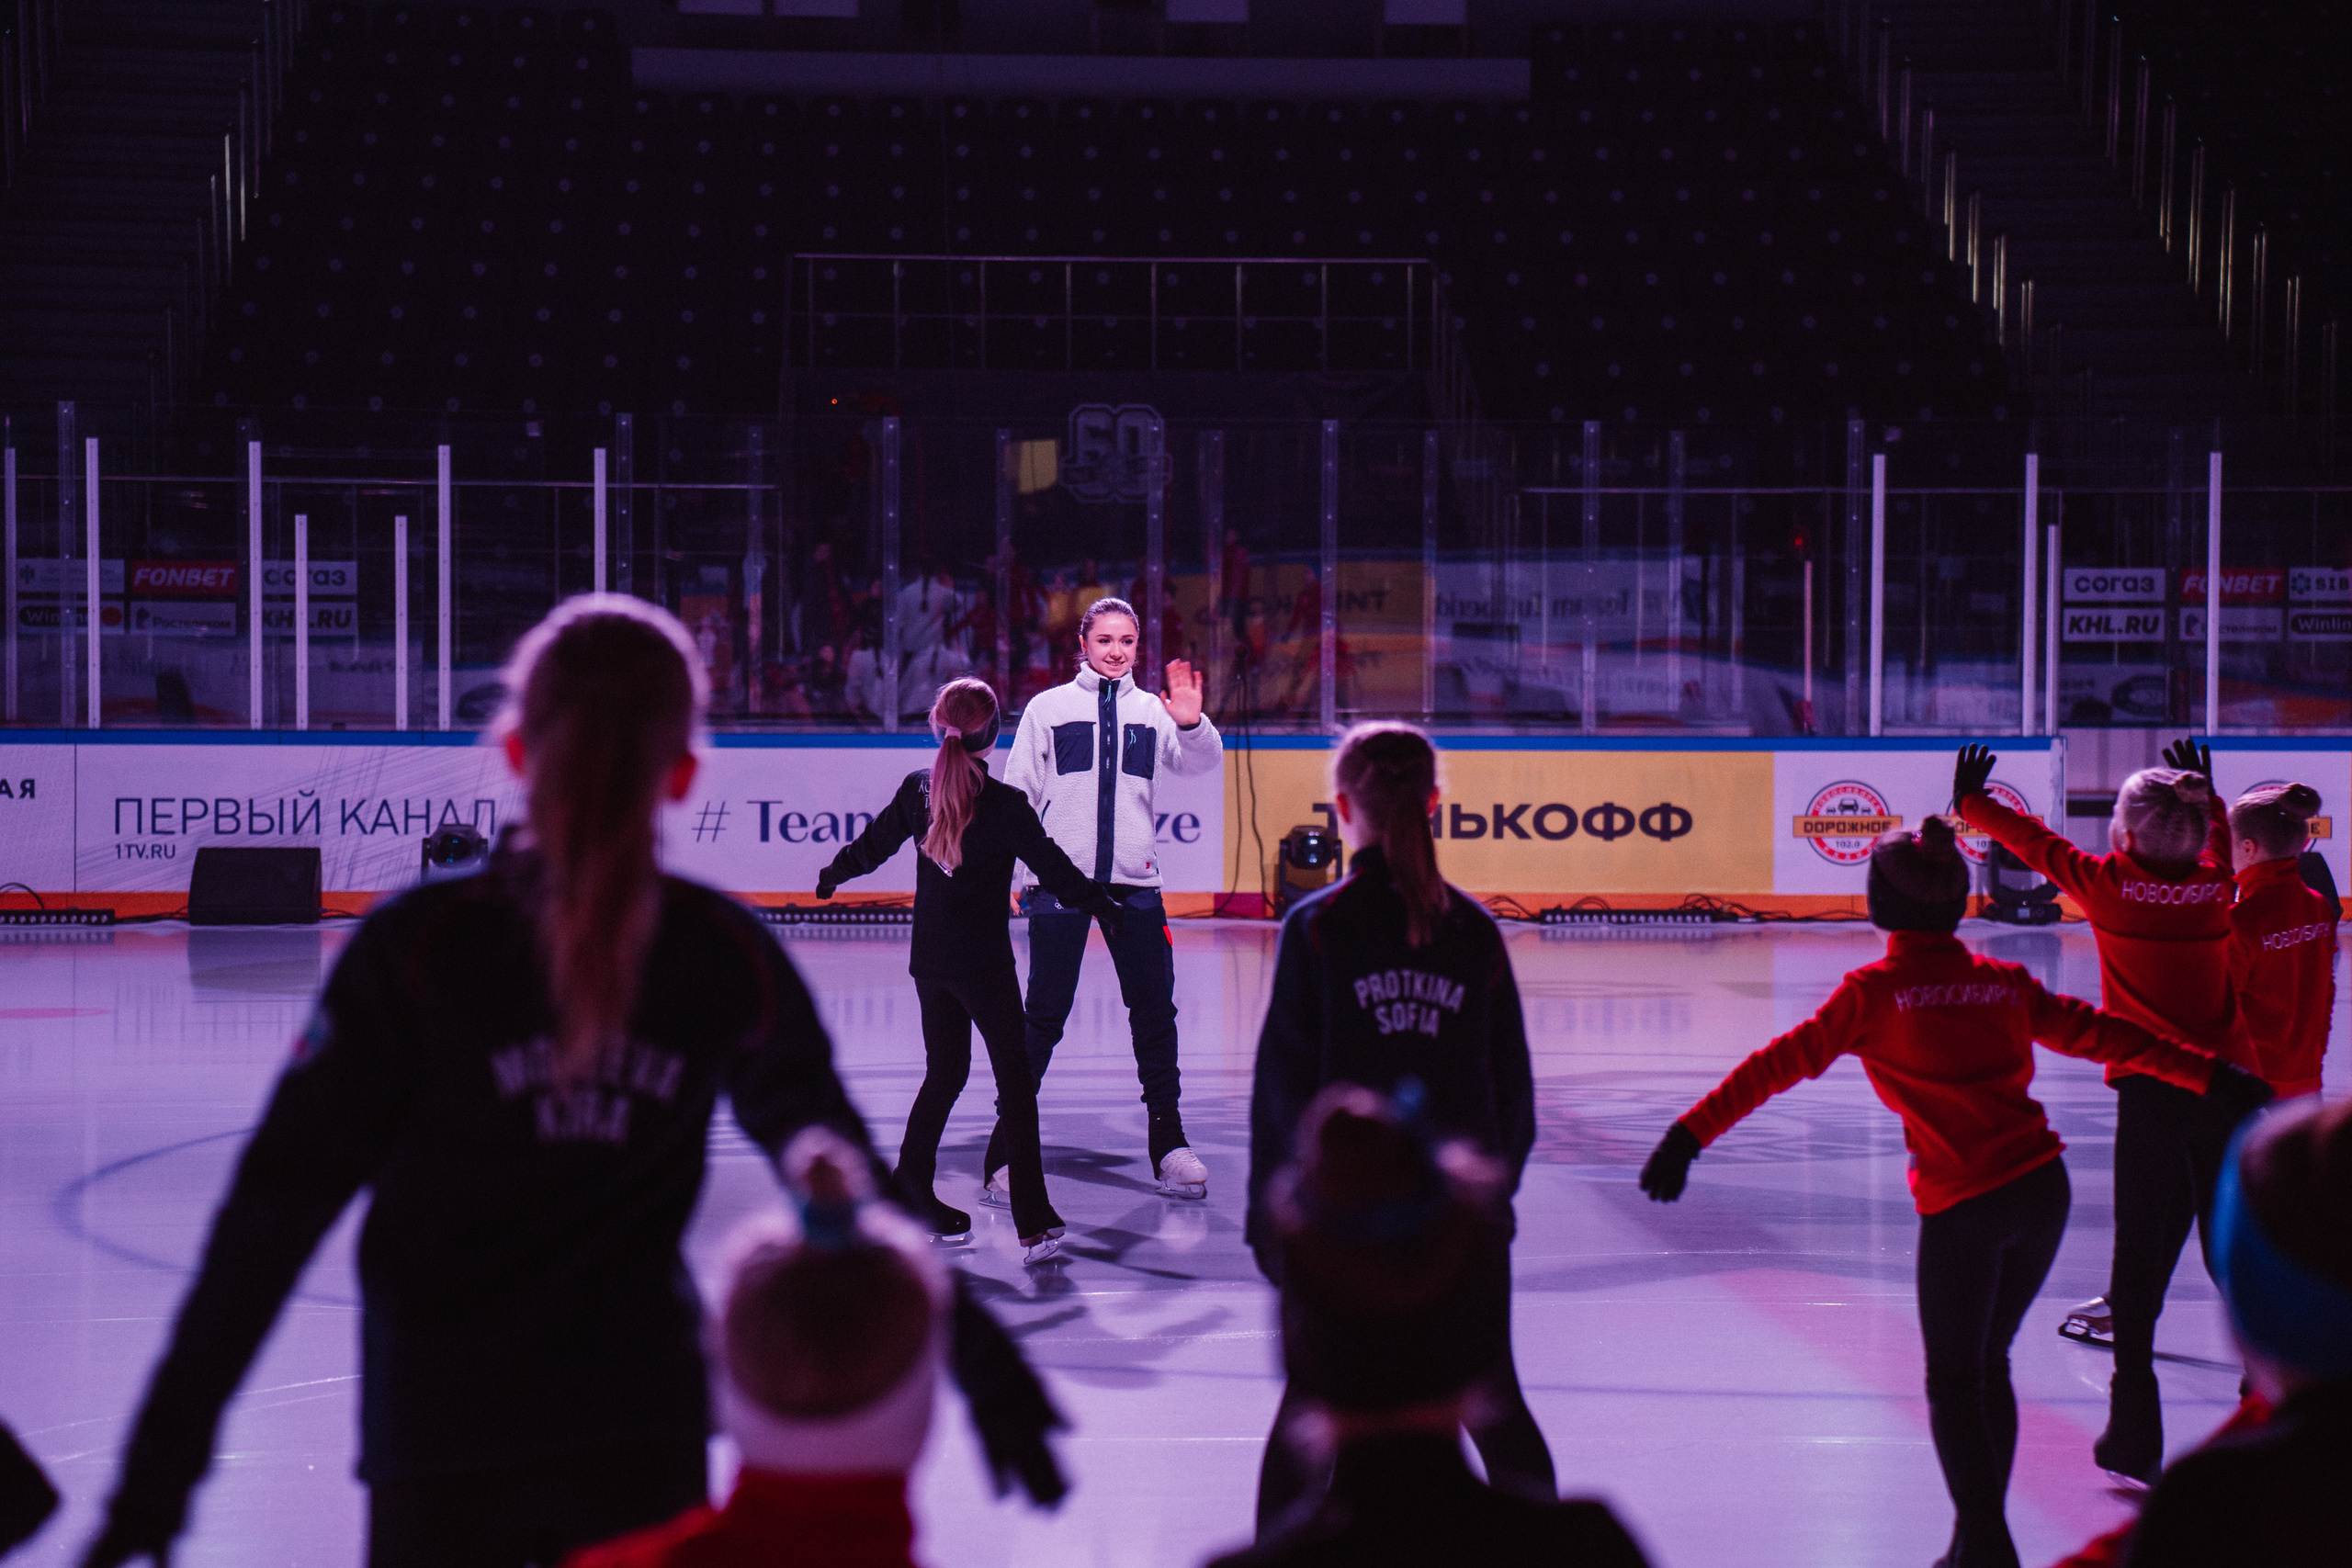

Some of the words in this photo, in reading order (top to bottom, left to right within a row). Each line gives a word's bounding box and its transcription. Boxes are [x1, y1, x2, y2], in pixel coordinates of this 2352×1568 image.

[133, 567, 235, 588] FONBET
[264, 570, 346, 586] соаз
[262, 609, 352, 628] KH.RU
[2068, 615, 2159, 635] KHL.RU
[0, 778, 35, 799] АЯ
[115, 790, 321, 835] ПЕРВЫЙ
[341, 799, 496, 835] КАНАЛ
[115, 843, 176, 860] 1TV.RU
[1352, 967, 1467, 1015] PROTKINA
[1374, 1001, 1442, 1039] SOFIA
